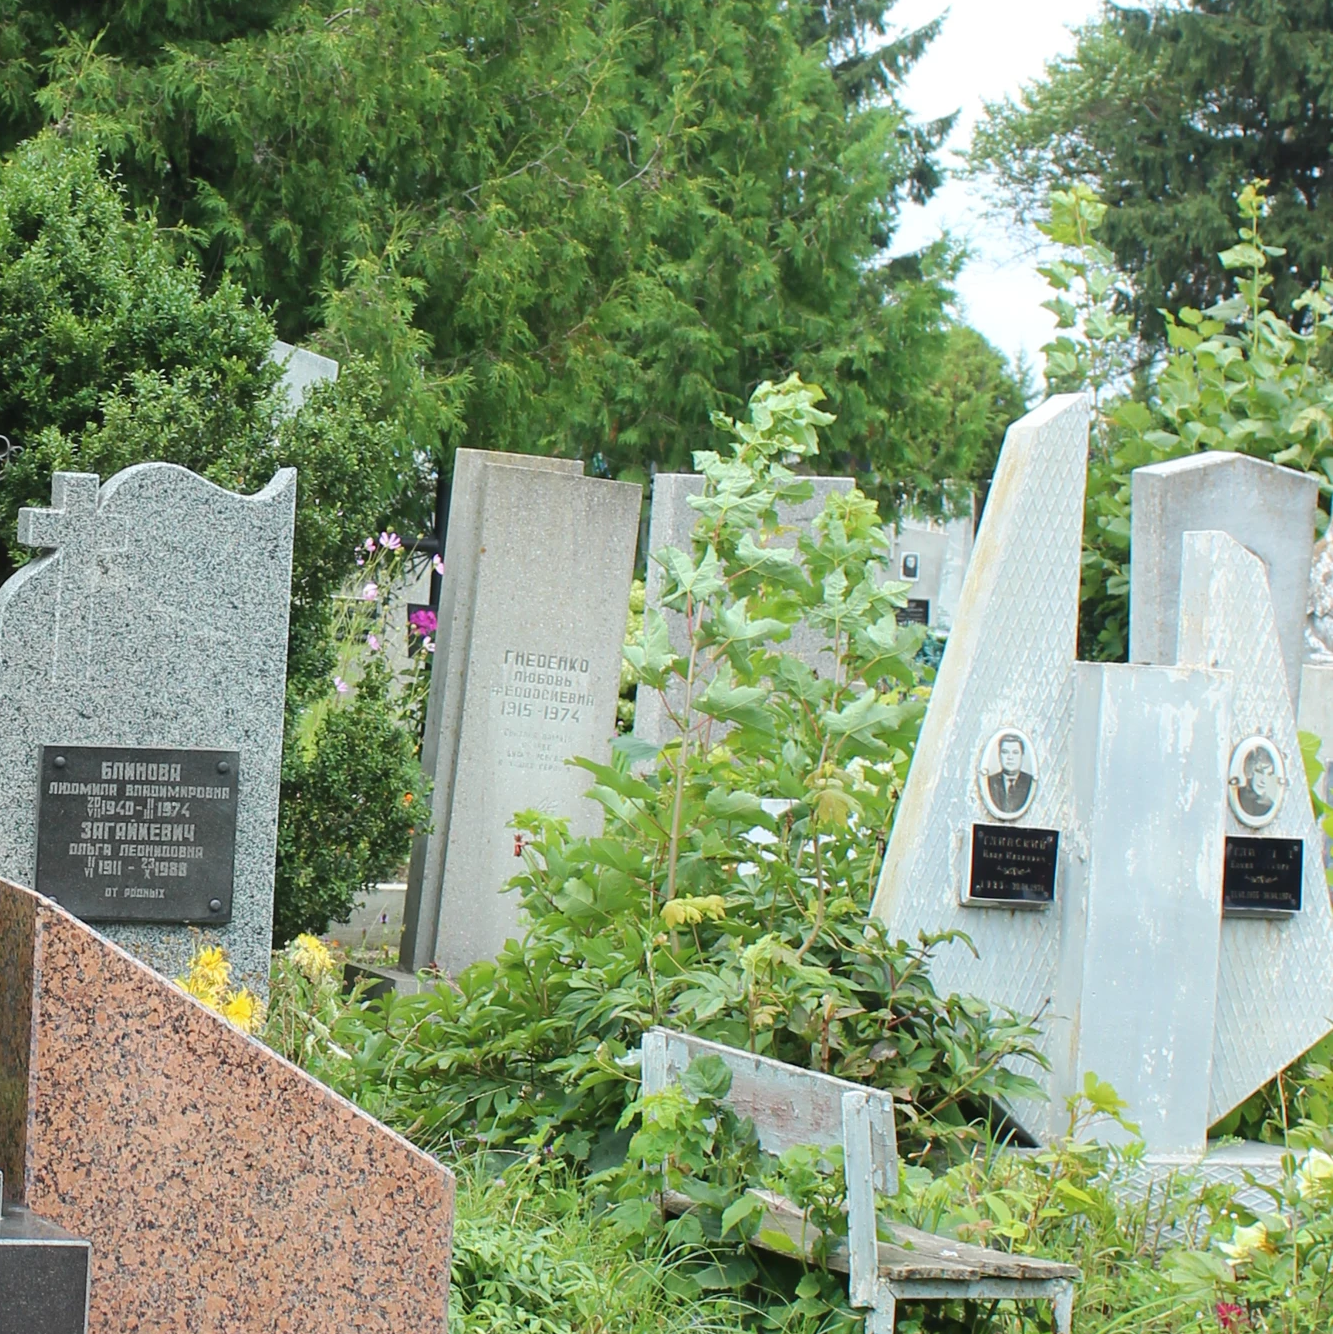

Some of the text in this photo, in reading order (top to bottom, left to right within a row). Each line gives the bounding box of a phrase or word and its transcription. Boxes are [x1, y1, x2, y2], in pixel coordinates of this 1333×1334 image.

[513, 670, 572, 688] ЛЮБОВЬ
[501, 700, 533, 717] 1915
[544, 705, 580, 723] 1974
[101, 761, 181, 782] БЛИНОВА
[48, 781, 230, 799] ЛЮДМИЛА ВЛАДИМИРОВНА
[157, 801, 190, 817] 1974
[80, 818, 195, 842] ЗАГАЙКЕВИЧ
[69, 842, 204, 859] ОЛЬГА ЛЕОНИДОВНА
[105, 887, 165, 899] ОТ РОДНЫХ
